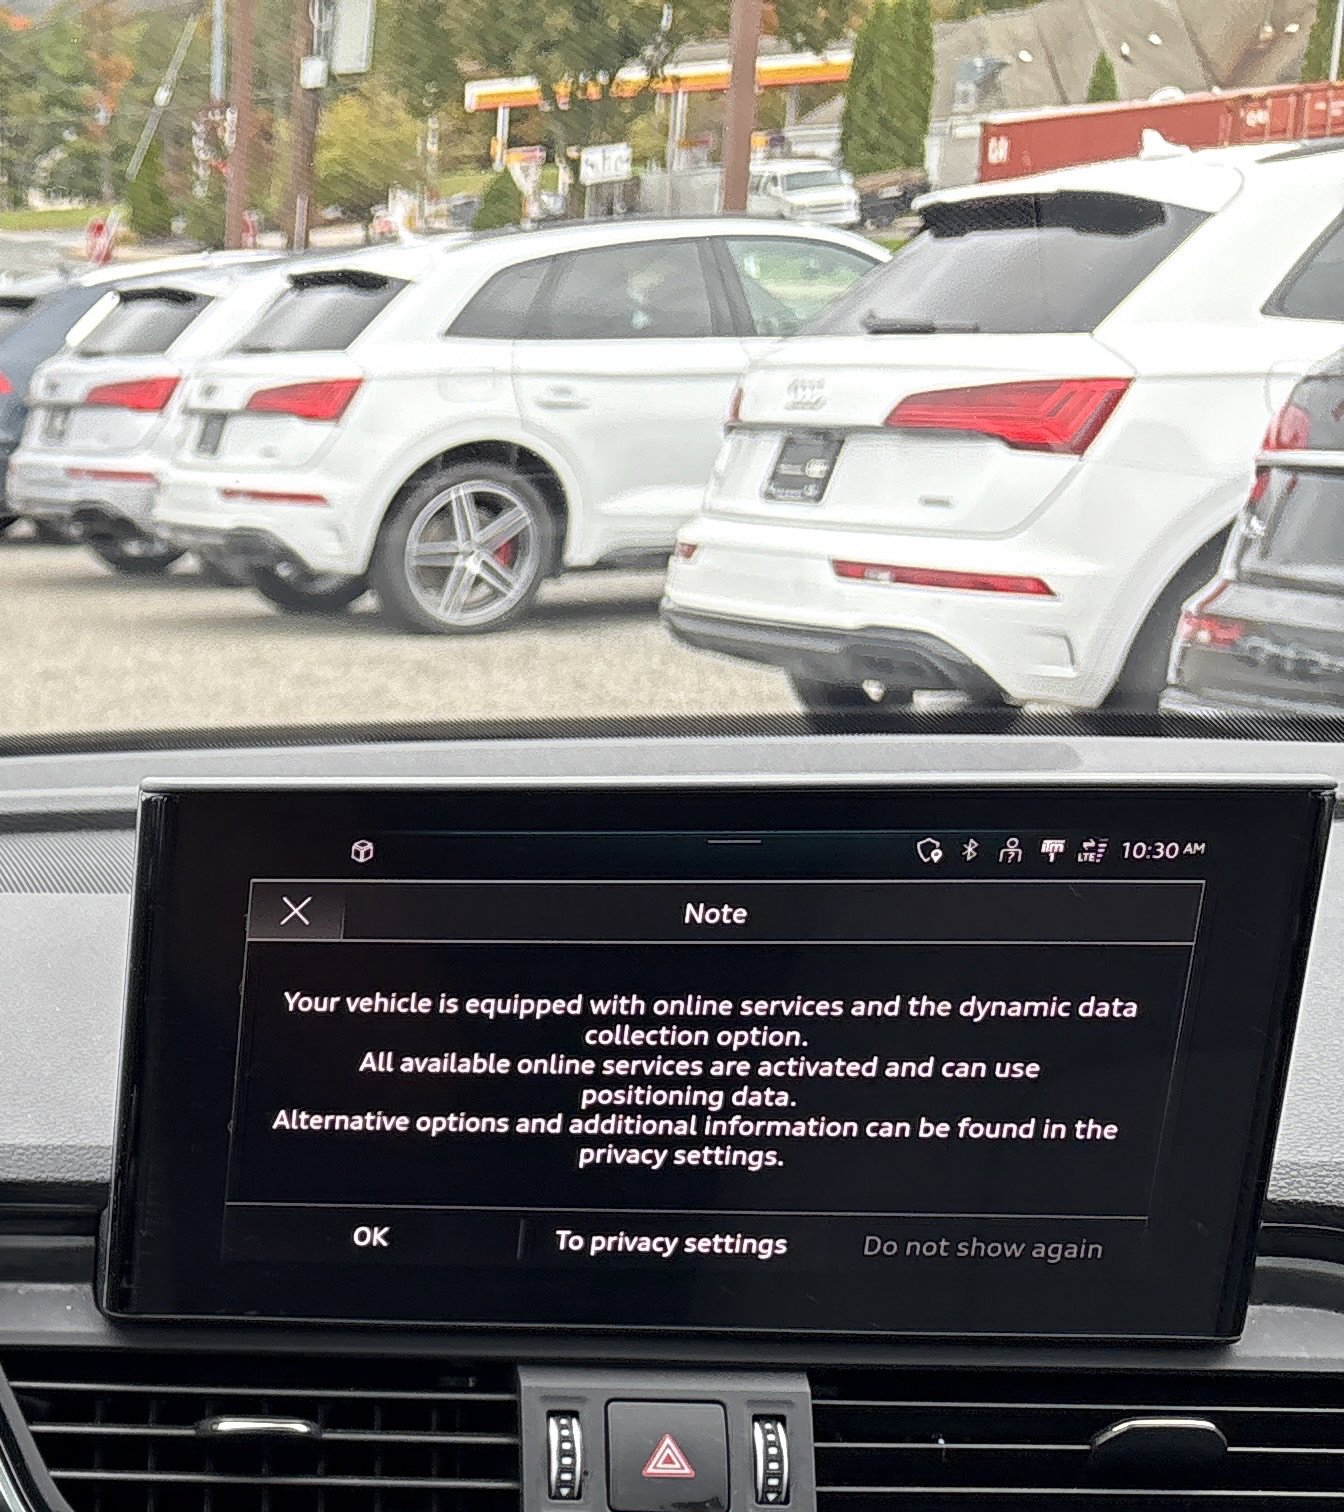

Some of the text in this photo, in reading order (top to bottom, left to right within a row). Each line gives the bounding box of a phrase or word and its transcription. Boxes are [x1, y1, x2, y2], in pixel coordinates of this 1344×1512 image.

[1078, 853, 1096, 861] LTE
[1123, 842, 1205, 858] 10:30 AM
[685, 903, 747, 923] Note
[284, 992, 1137, 1022] Your vehicle is equipped with online services and the dynamic data
[585, 1024, 807, 1051] collection option.
[359, 1052, 1040, 1078] All available online services are activated and can use
[581, 1085, 796, 1111] positioning data.
[272, 1109, 1118, 1139] Alternative options and additional information can be found in the
[579, 1144, 783, 1171] privacy settings.
[354, 1226, 389, 1246] OK
[556, 1230, 787, 1259] To privacy settings
[864, 1236, 1102, 1263] Do not show again
